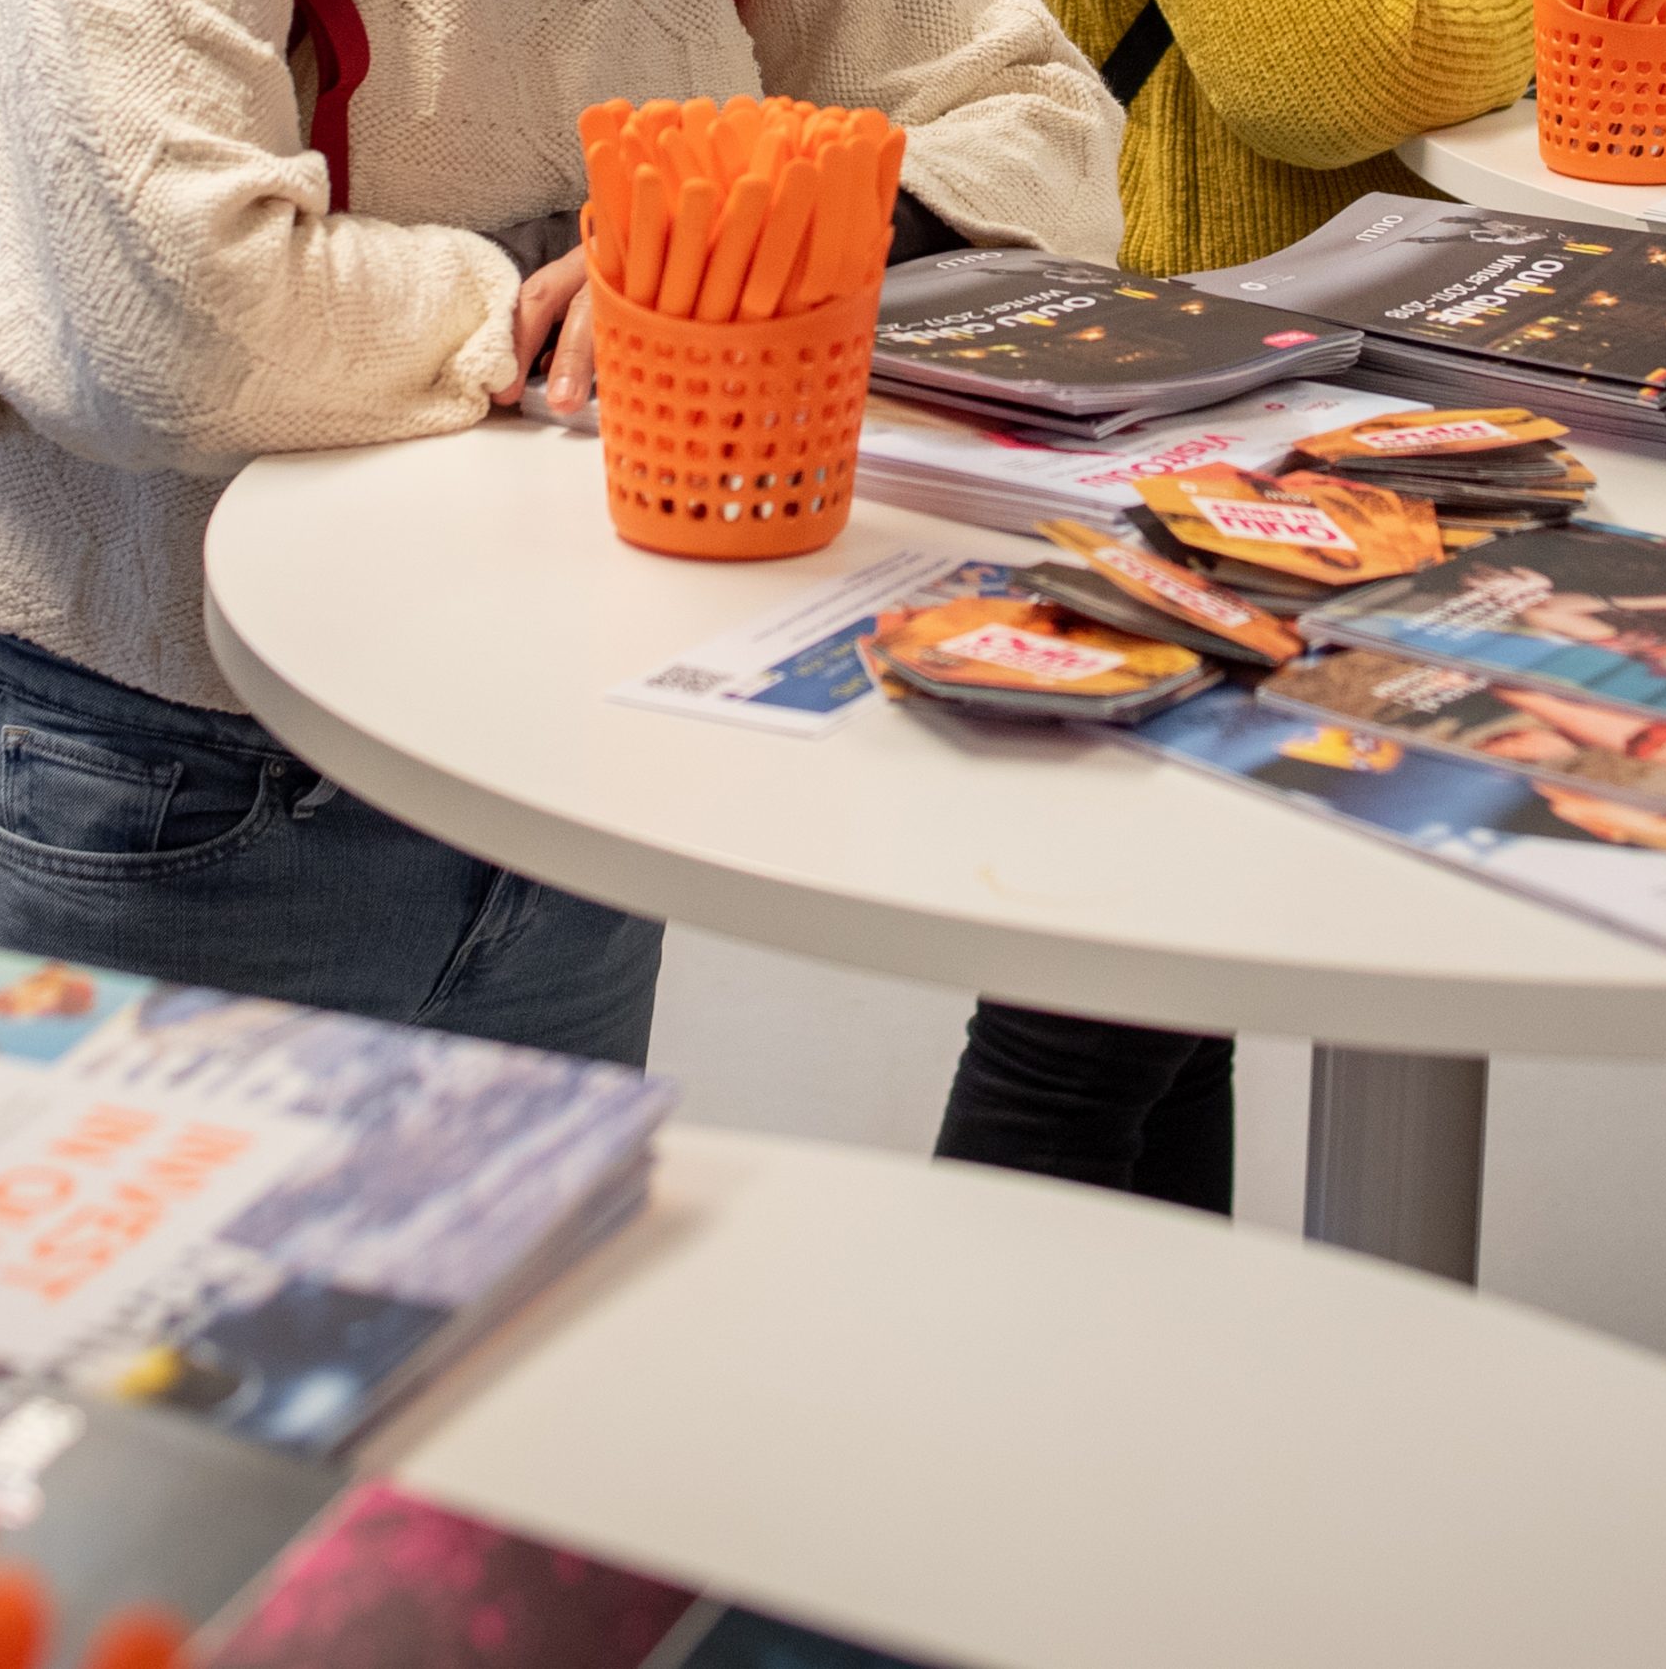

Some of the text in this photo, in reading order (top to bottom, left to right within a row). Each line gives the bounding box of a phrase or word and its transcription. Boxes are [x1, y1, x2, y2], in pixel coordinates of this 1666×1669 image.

[1355, 214, 1404, 243] OULU
[936, 251, 1003, 270] OULU
[1464, 253, 1527, 286] Winter
[983, 288, 1071, 315] Winter
[1425, 259, 1565, 326] OULU GUIDE
[995, 296, 1097, 328] OULU
[1219, 514, 1338, 542] Oulu
